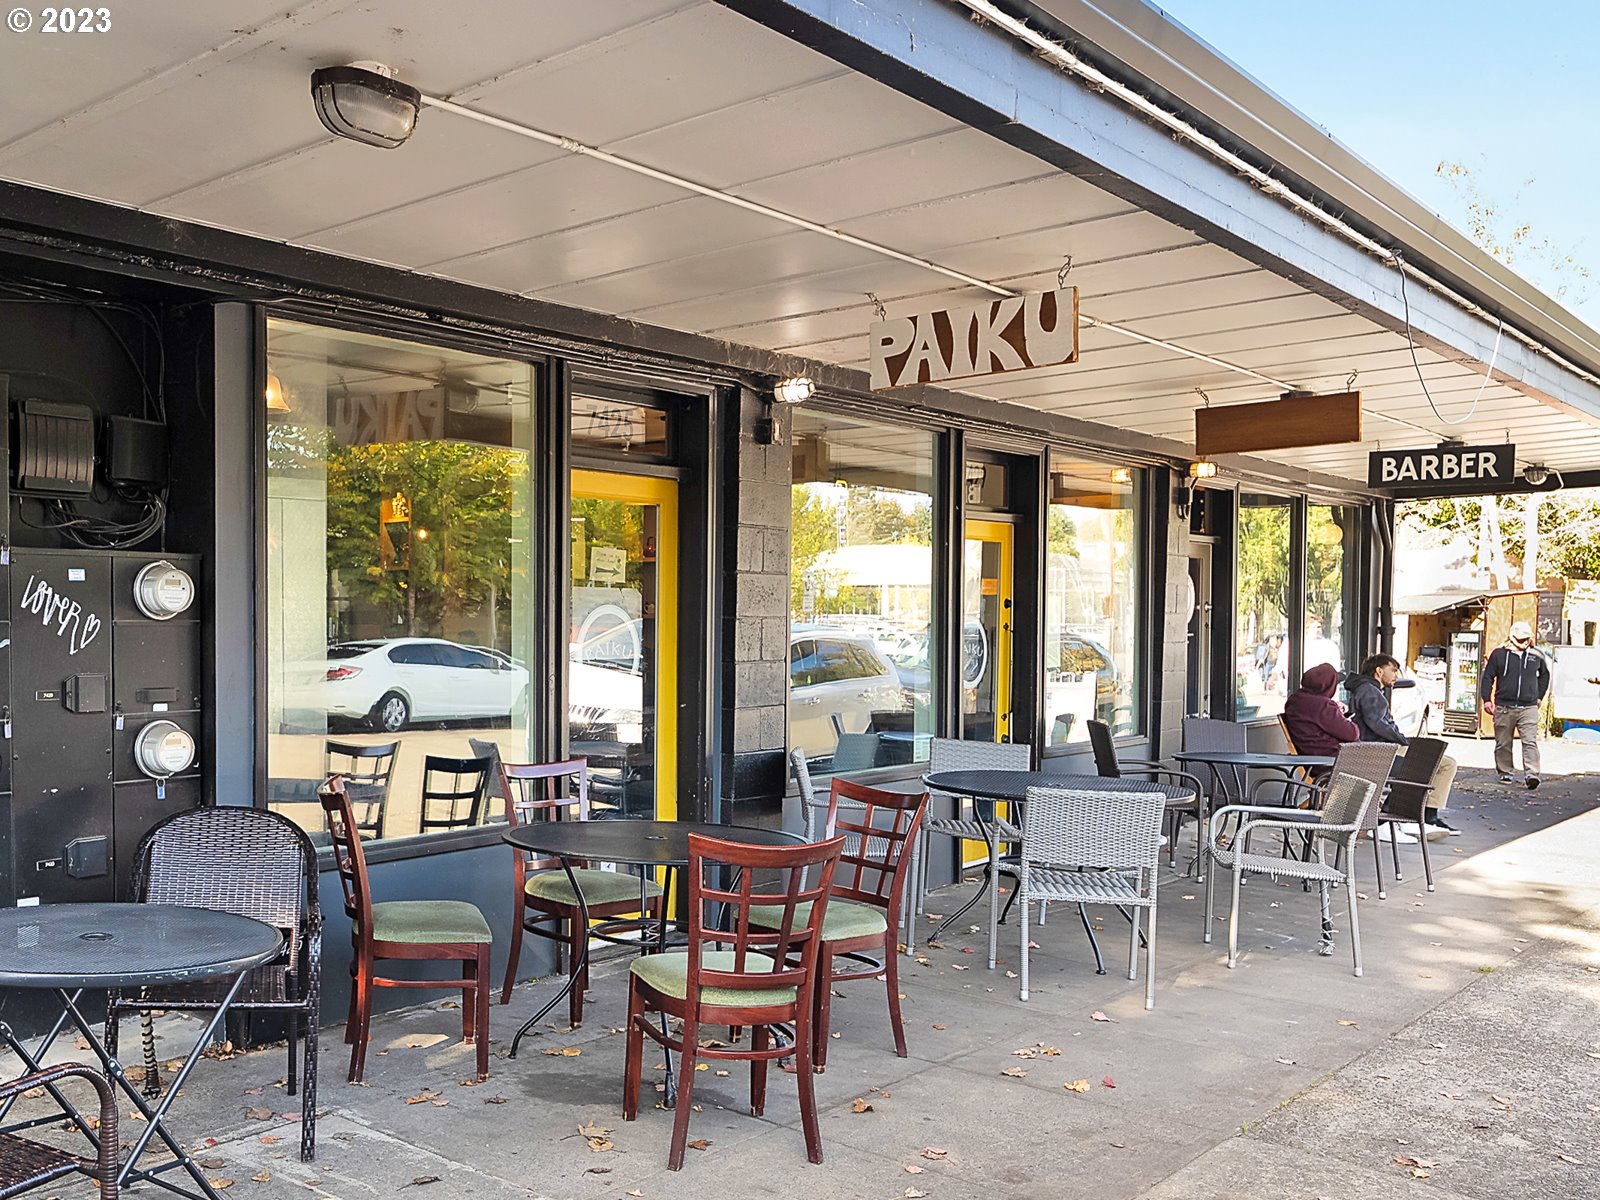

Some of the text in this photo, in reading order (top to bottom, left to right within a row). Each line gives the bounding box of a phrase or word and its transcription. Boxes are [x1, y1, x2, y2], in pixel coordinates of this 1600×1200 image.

[870, 289, 1075, 390] PAIKU
[586, 404, 634, 441] 7425
[1382, 452, 1499, 482] BARBER
